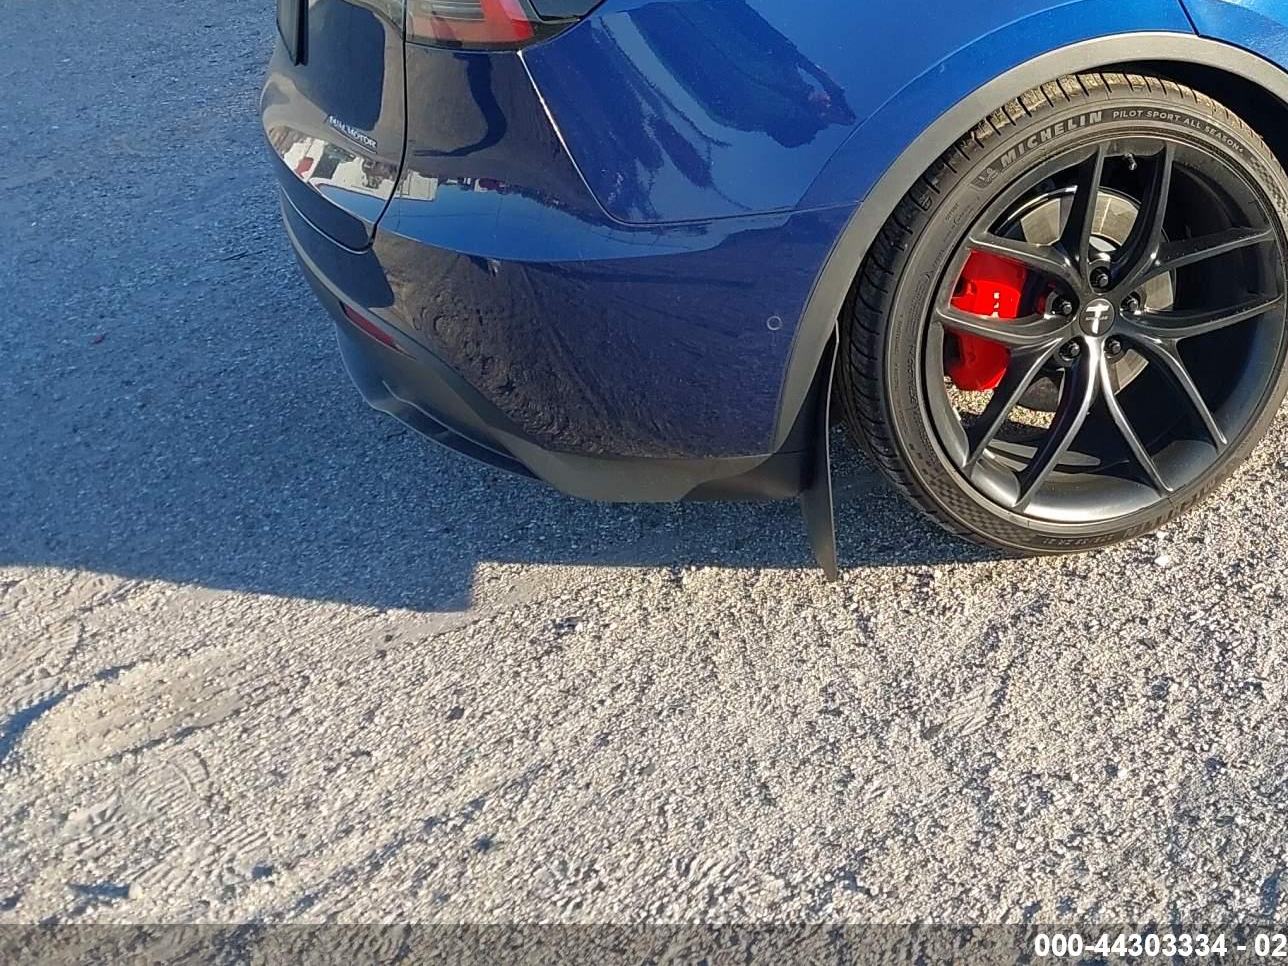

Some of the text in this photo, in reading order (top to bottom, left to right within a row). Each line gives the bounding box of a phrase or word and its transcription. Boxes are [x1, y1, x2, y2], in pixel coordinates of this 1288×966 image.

[999, 111, 1103, 169] MICHELIN
[1112, 109, 1142, 119] PILOT
[1146, 109, 1181, 123] SPORT
[1183, 117, 1203, 131] ALL
